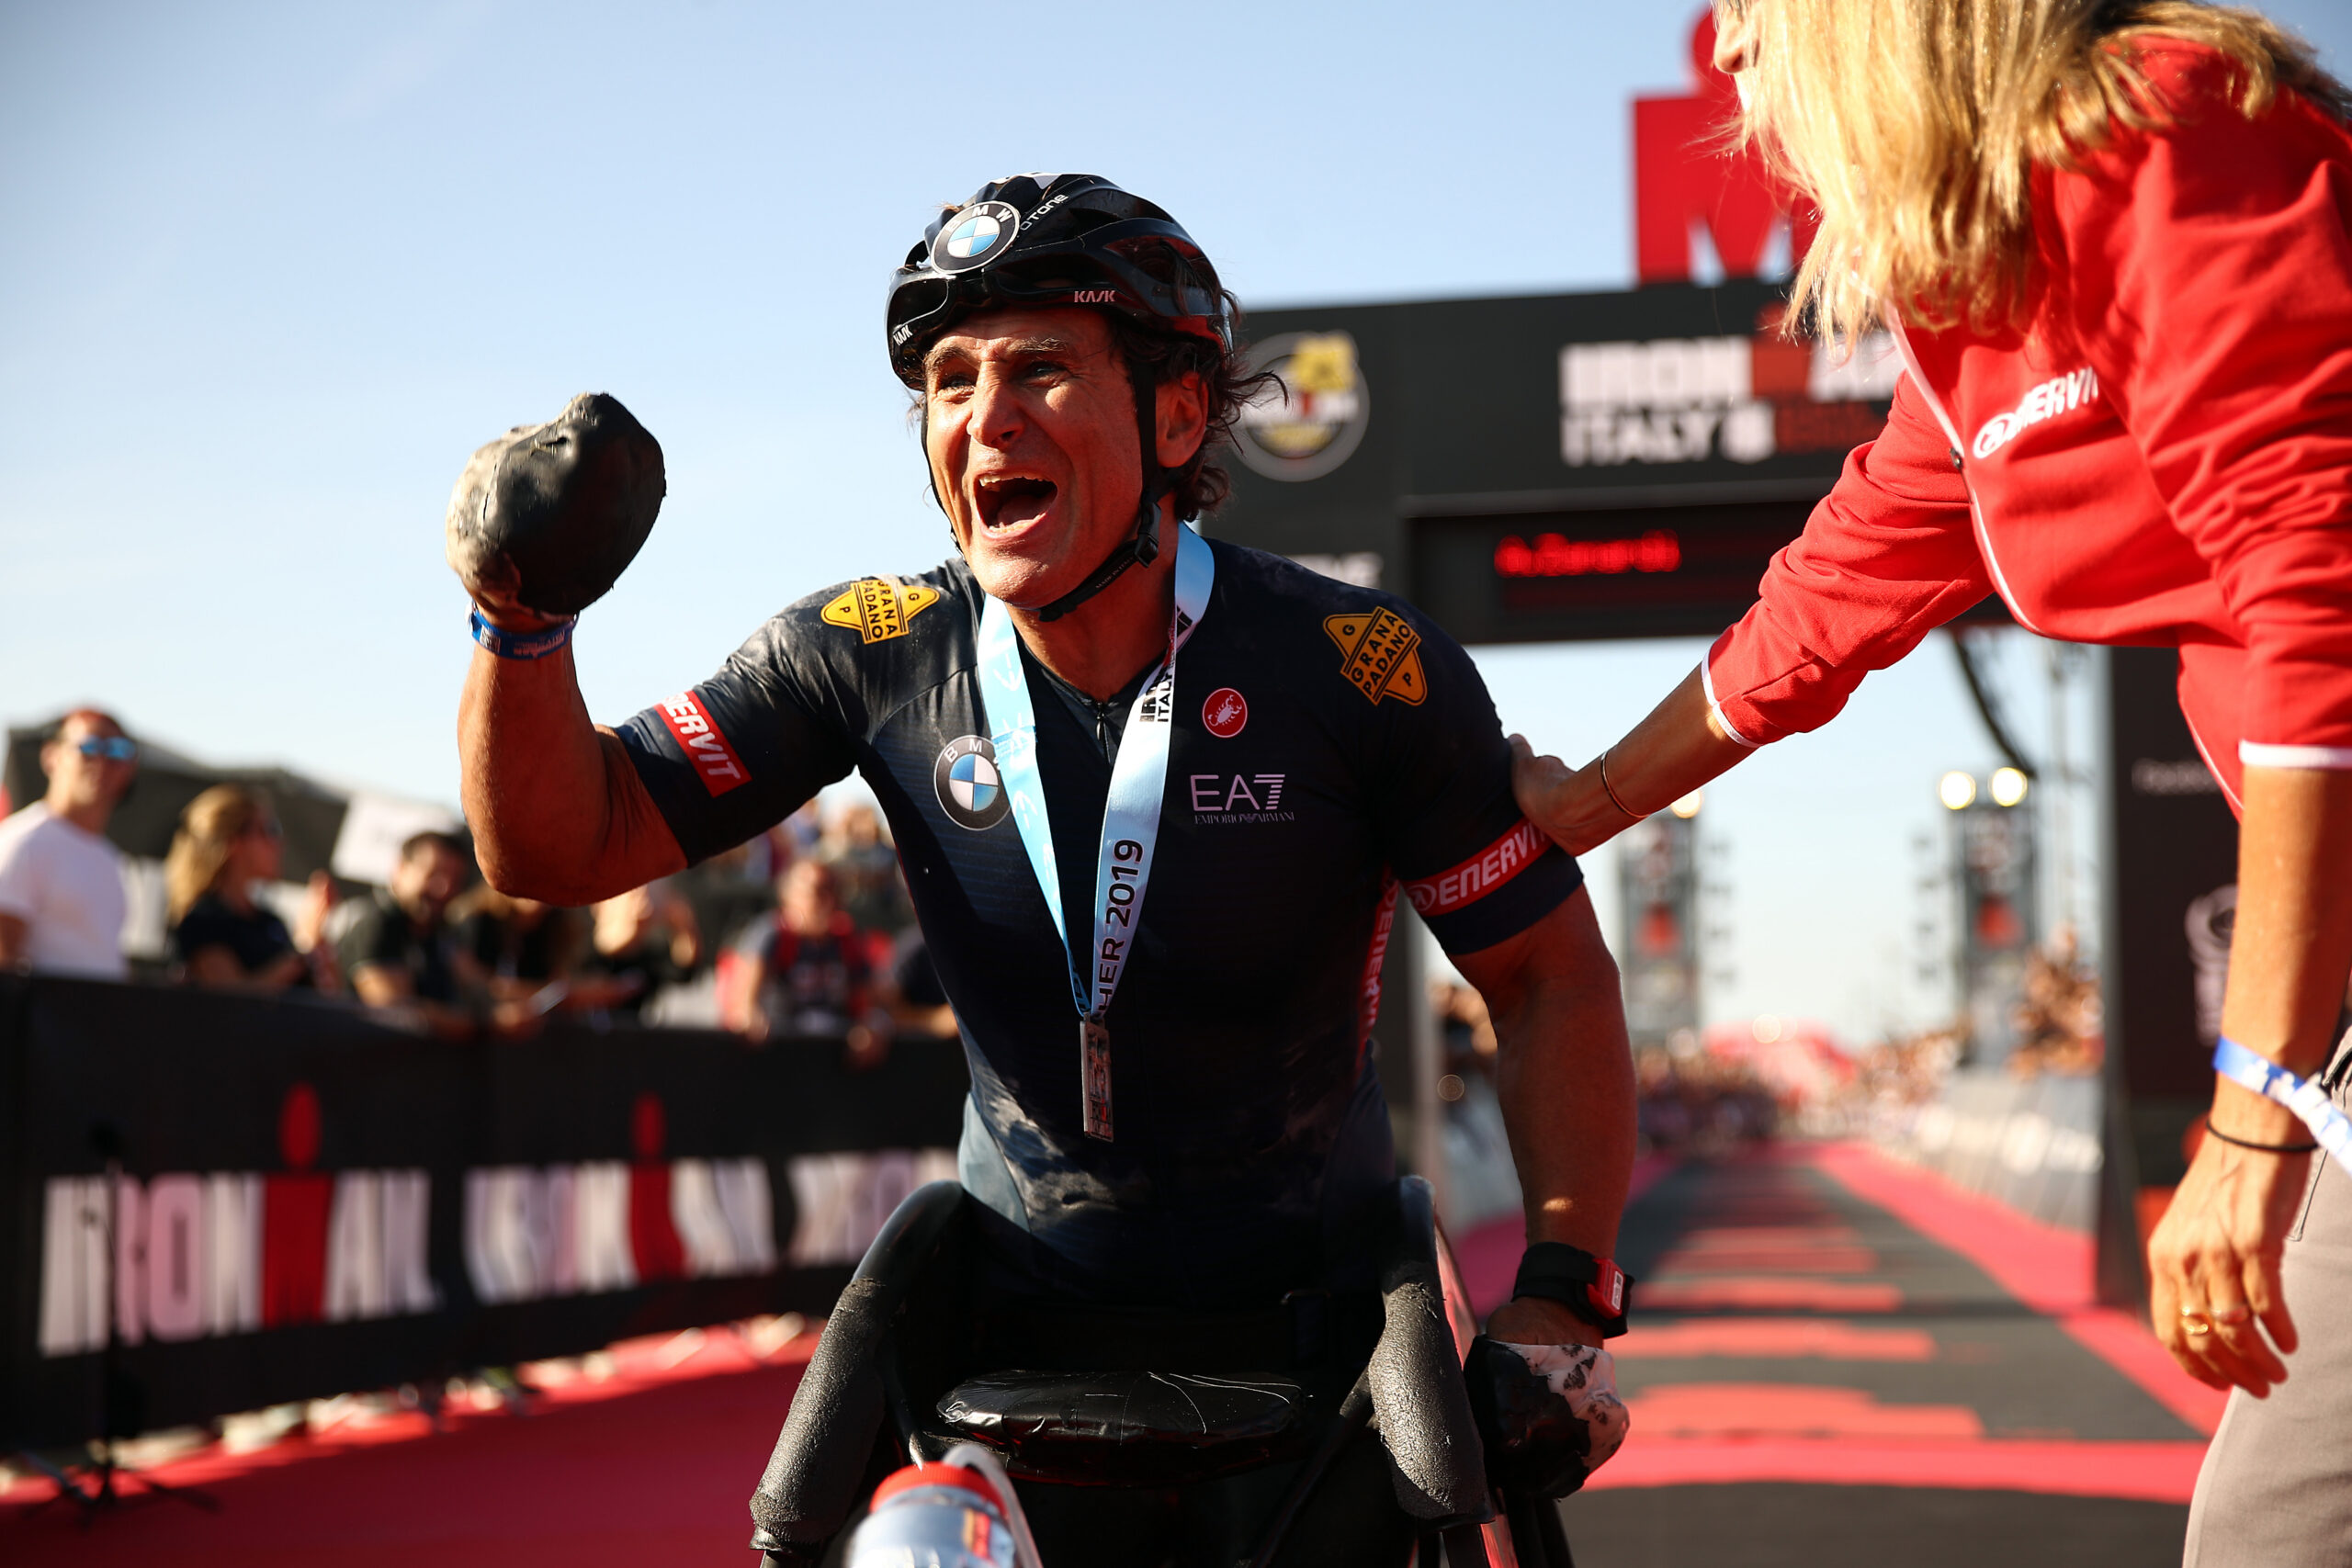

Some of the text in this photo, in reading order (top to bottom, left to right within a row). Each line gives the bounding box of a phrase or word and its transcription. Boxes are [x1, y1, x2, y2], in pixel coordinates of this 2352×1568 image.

[944, 204, 1014, 233] BMW
[1074, 289, 1116, 303] KASK
[1342, 624, 1356, 636] G
[1351, 614, 1399, 683] GRANA
[1363, 624, 1411, 696] PADANO
[1402, 671, 1412, 687] P
[1190, 773, 1286, 811] EA7
[1194, 811, 1295, 825] EMPORIO ARMANI
[1105, 839, 1145, 929] 2019
